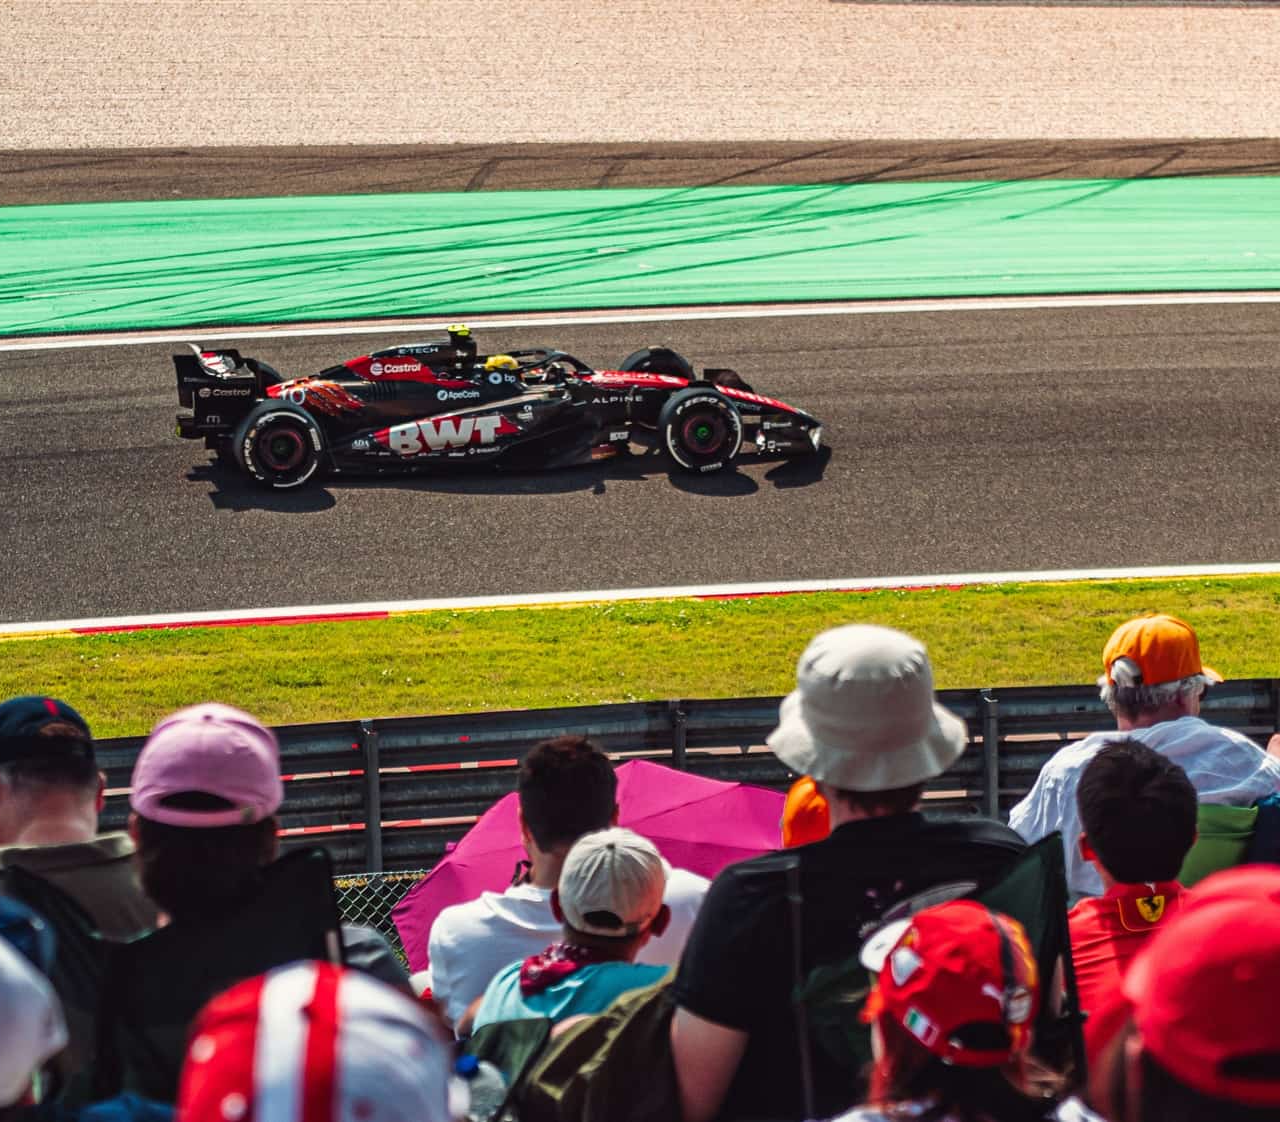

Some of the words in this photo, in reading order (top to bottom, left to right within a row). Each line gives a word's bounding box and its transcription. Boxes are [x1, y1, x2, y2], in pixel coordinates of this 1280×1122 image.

[399, 346, 439, 354] E-TECH
[383, 363, 421, 374] Castrol
[504, 374, 516, 383] bp
[212, 388, 251, 397] Castrol
[448, 390, 480, 400] ApeCoin
[592, 395, 643, 404] ALPINE
[389, 415, 502, 455] BWT
